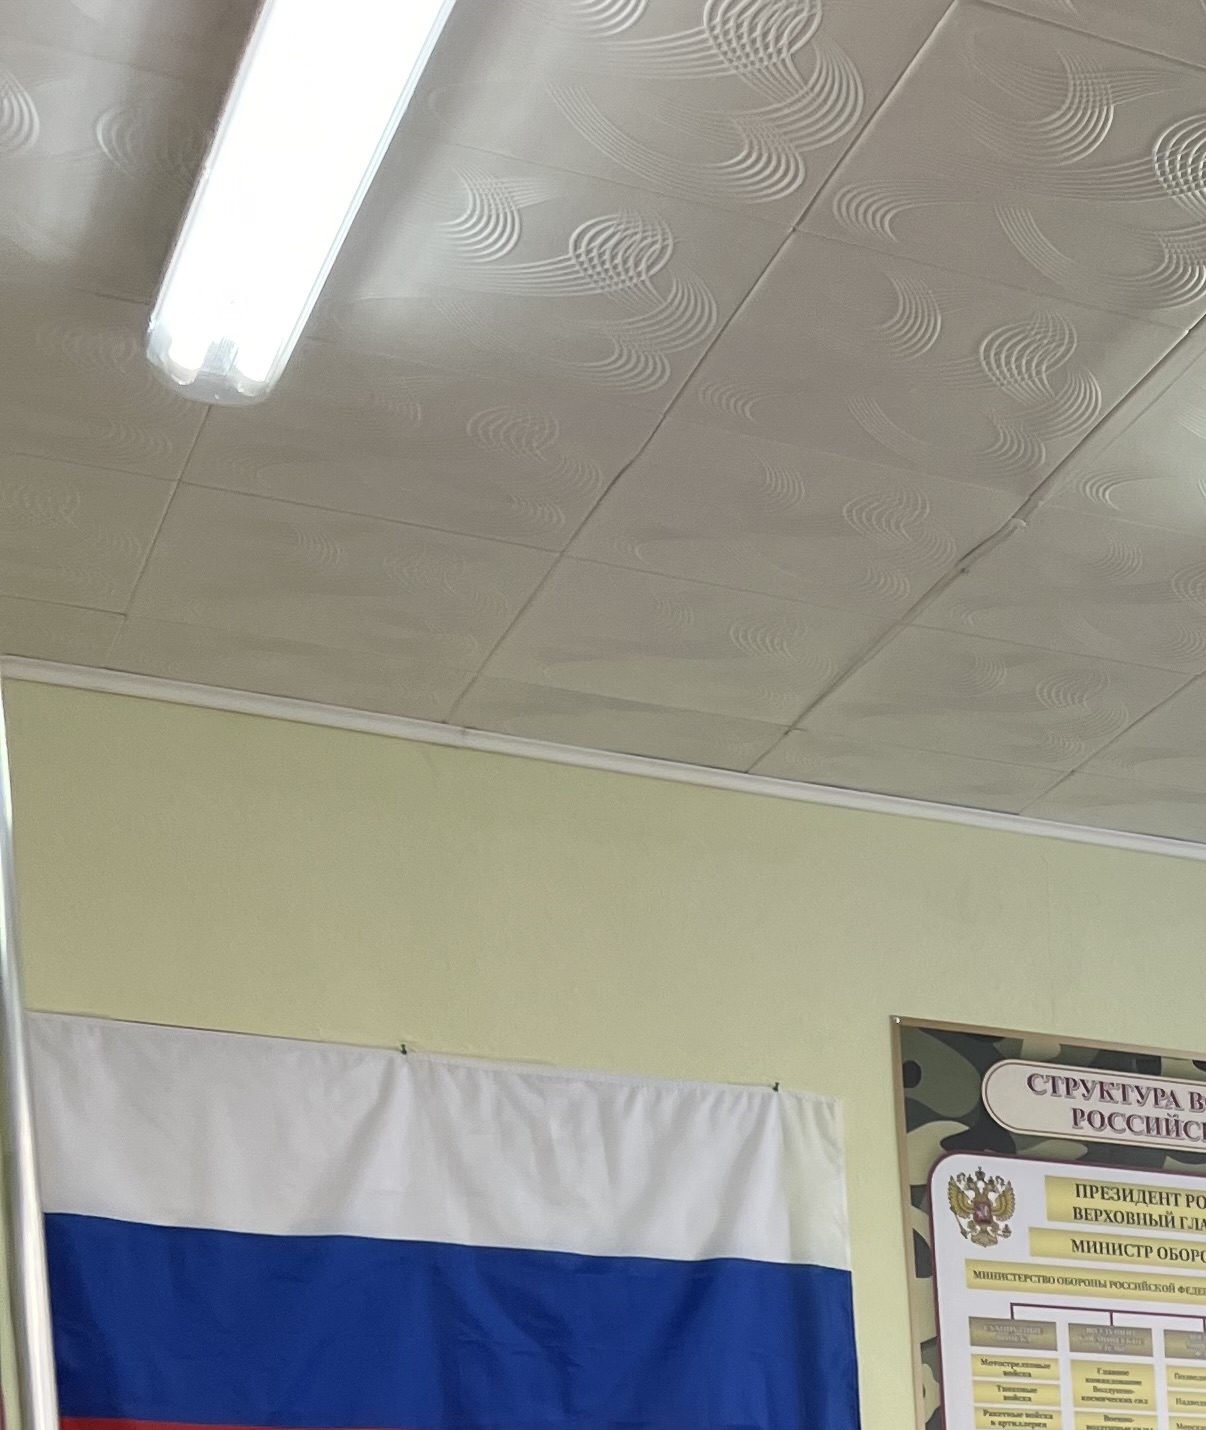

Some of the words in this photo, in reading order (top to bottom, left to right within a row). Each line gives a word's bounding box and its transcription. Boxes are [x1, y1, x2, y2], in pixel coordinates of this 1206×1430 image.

[1027, 1073, 1184, 1111] СТРУКТУРА
[1075, 1183, 1181, 1207] ПРЕЗИДЕНТ
[1073, 1206, 1176, 1229] ВЕРХОВНЫЙ
[1071, 1239, 1153, 1258] МИНИСТР
[973, 1270, 1055, 1285] МИНИСТЕРСТВО
[1057, 1276, 1107, 1288] ОБОРОНЫ
[1109, 1280, 1175, 1293] РОССИЙСКОЙ
